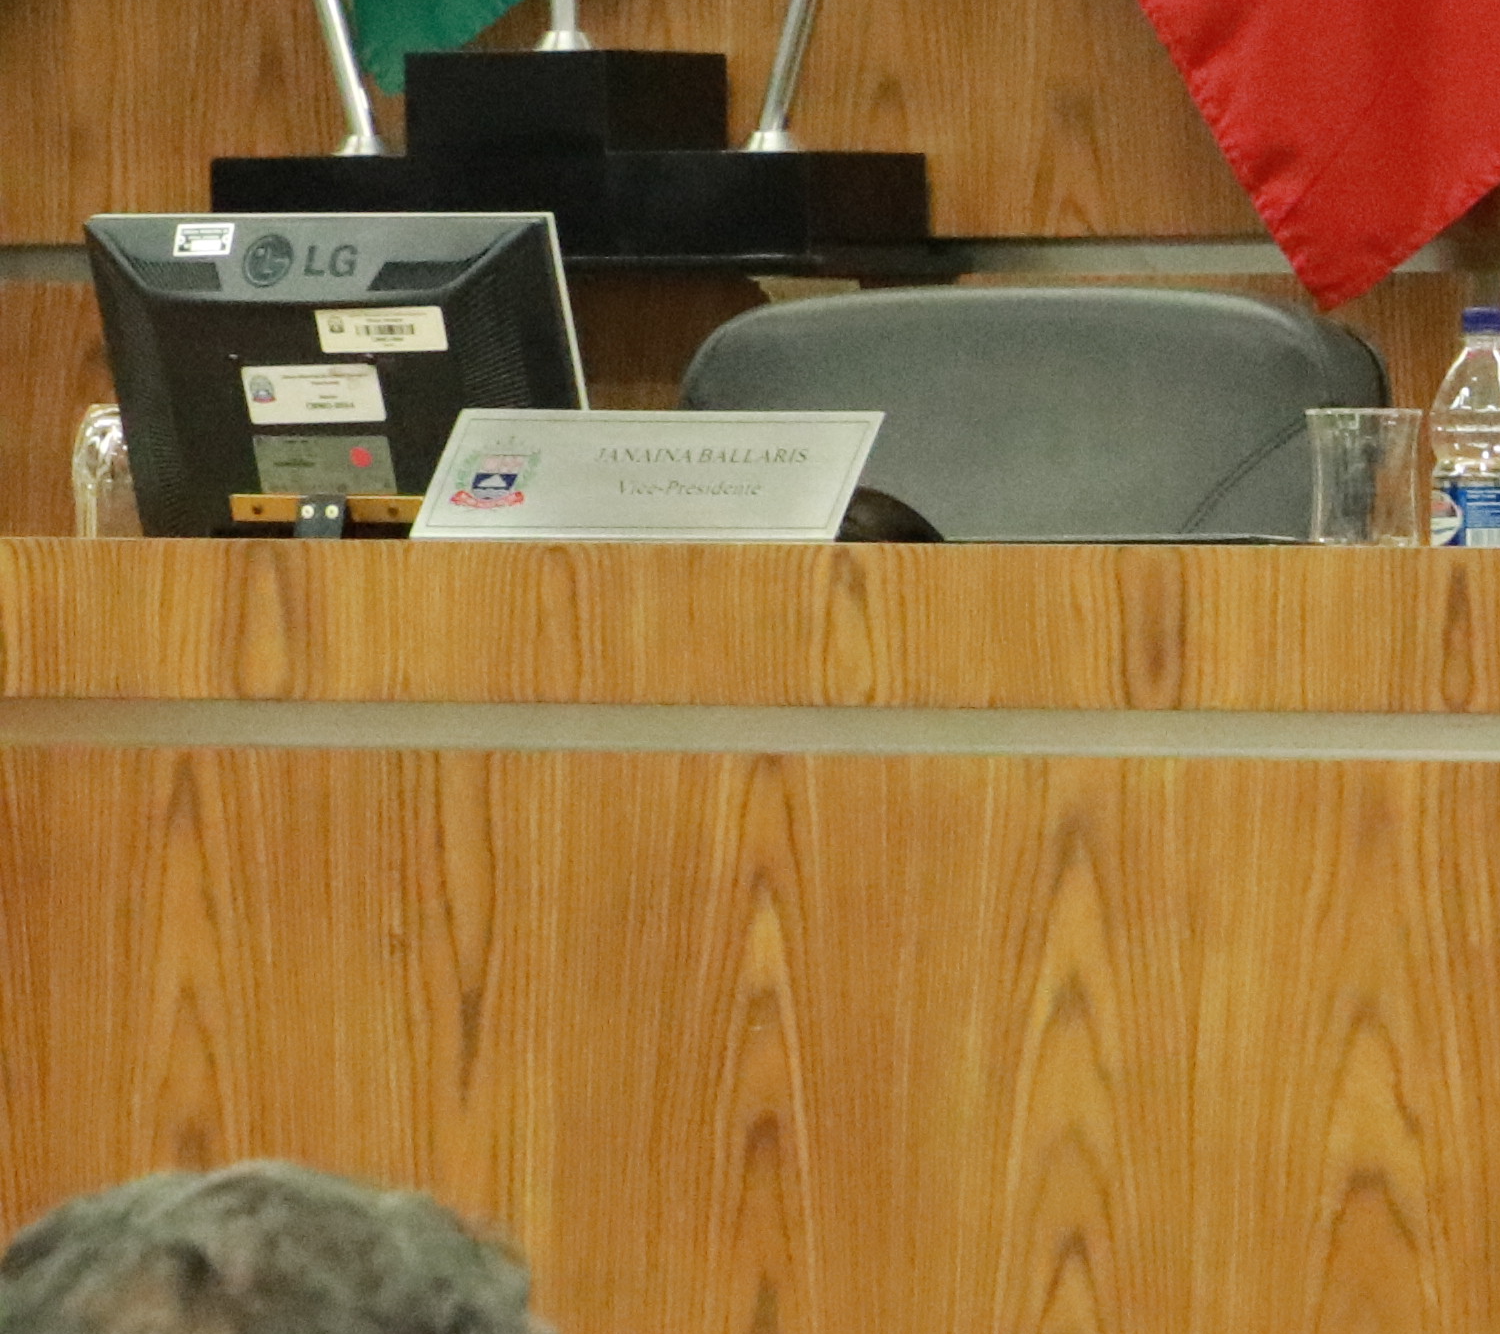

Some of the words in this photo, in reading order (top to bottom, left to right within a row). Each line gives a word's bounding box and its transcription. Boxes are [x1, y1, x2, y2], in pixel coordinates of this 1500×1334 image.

[303, 244, 359, 277] LG
[698, 447, 809, 464] BALLARIS
[618, 479, 764, 496] Vice-Presidente
